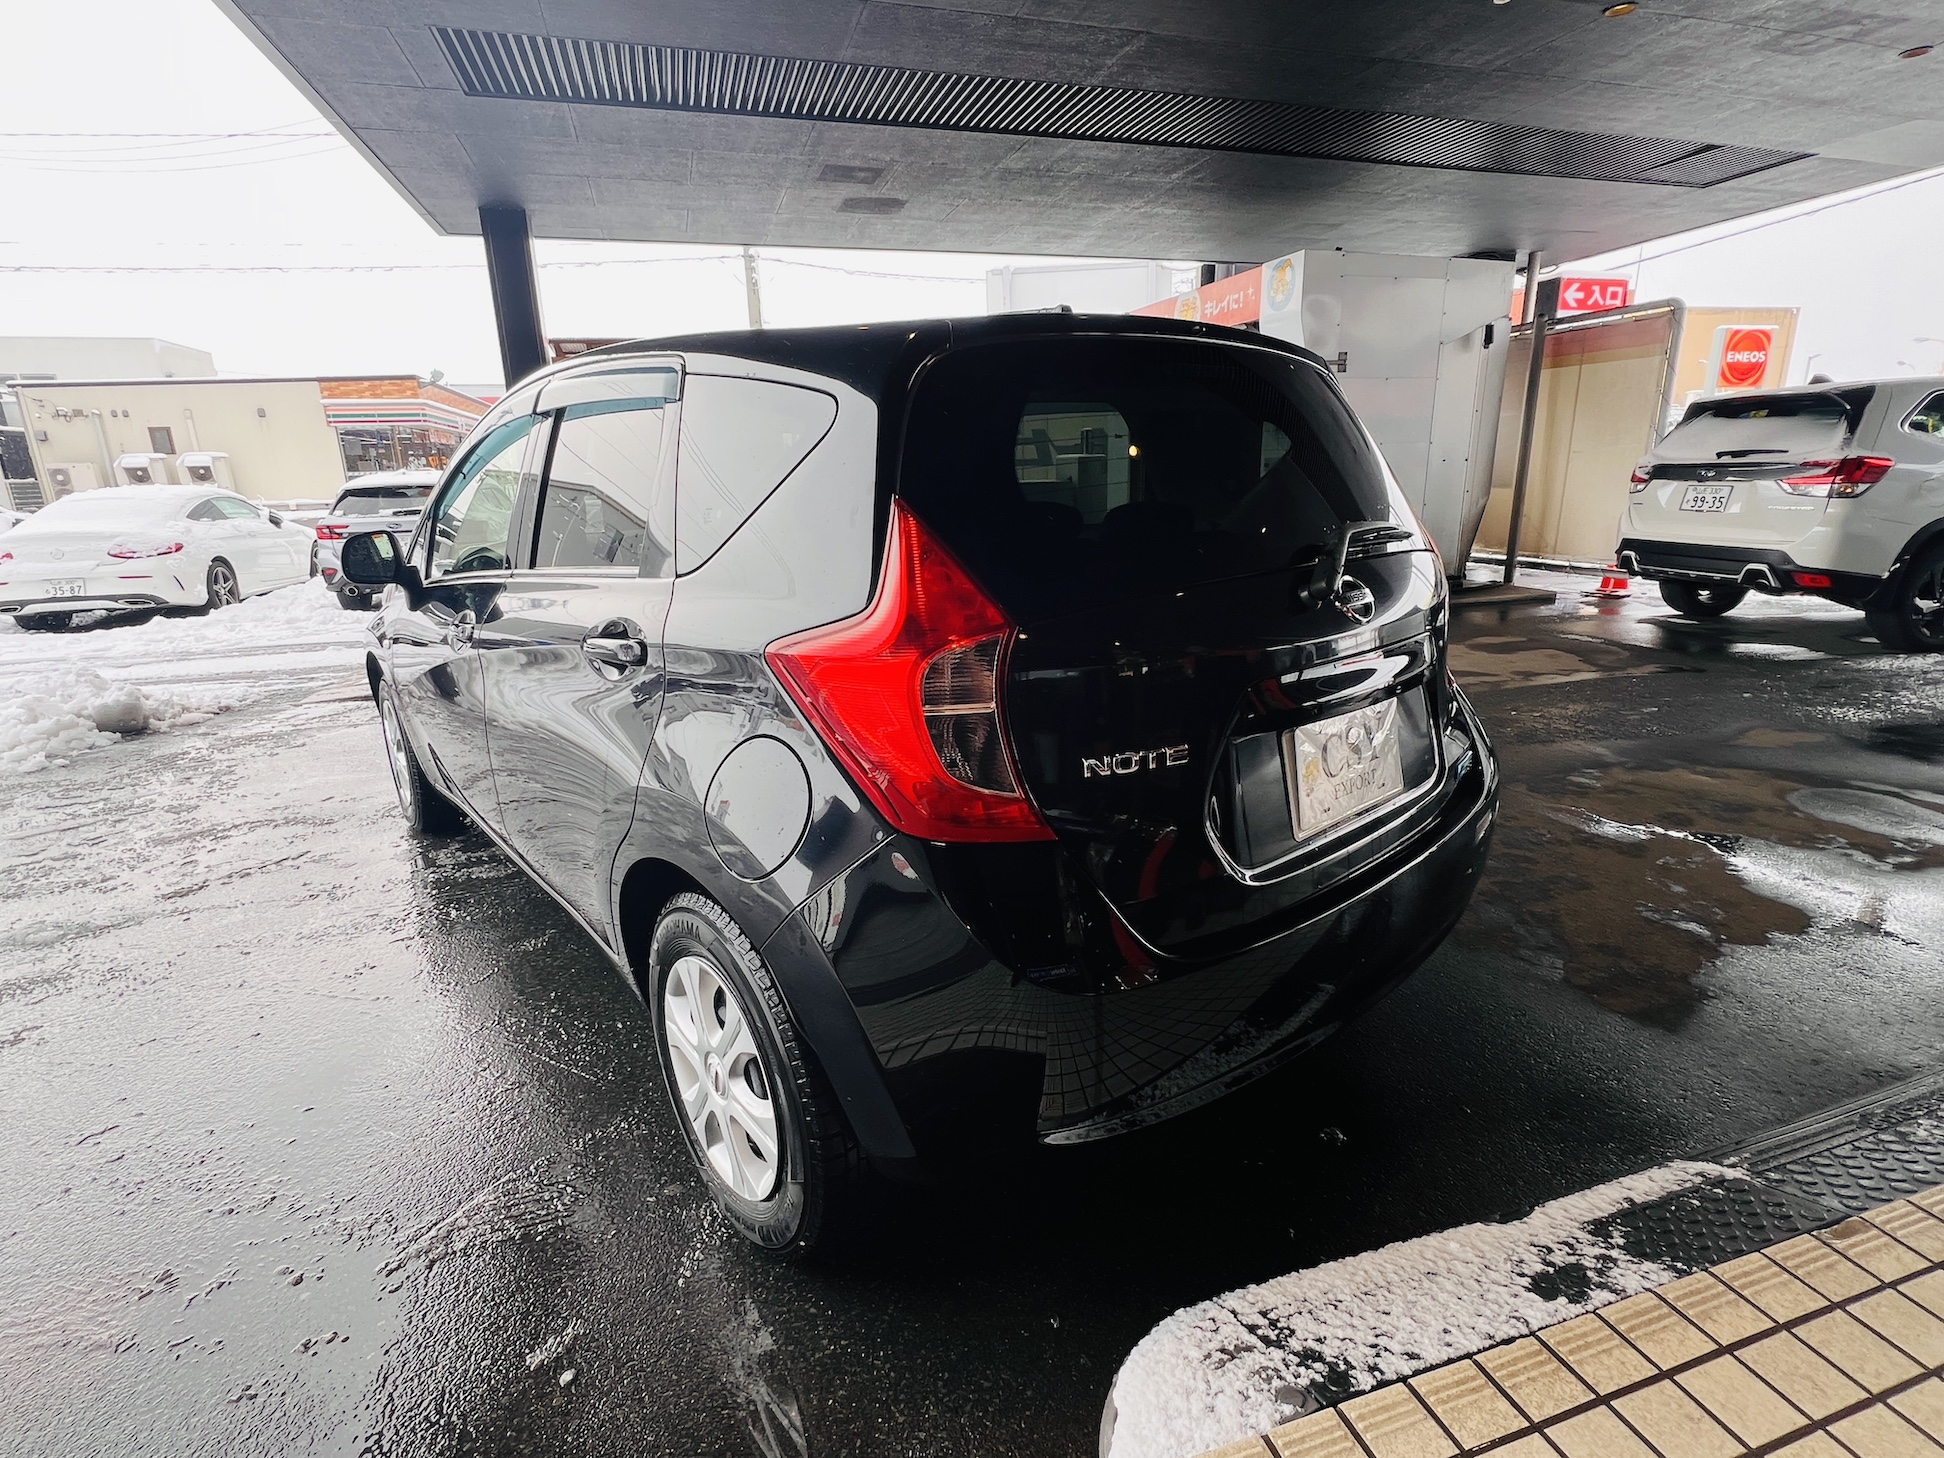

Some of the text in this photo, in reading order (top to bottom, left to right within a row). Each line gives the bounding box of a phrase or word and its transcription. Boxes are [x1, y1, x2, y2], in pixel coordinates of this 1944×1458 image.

[1204, 290, 1244, 318] キレイに!
[1587, 285, 1623, 307] 入口
[1726, 350, 1766, 363] ENEOS
[1690, 495, 1726, 509] 99-35
[51, 585, 82, 596] 35-87
[1081, 744, 1189, 778] NOTE
[1333, 768, 1378, 800] EXPORT
